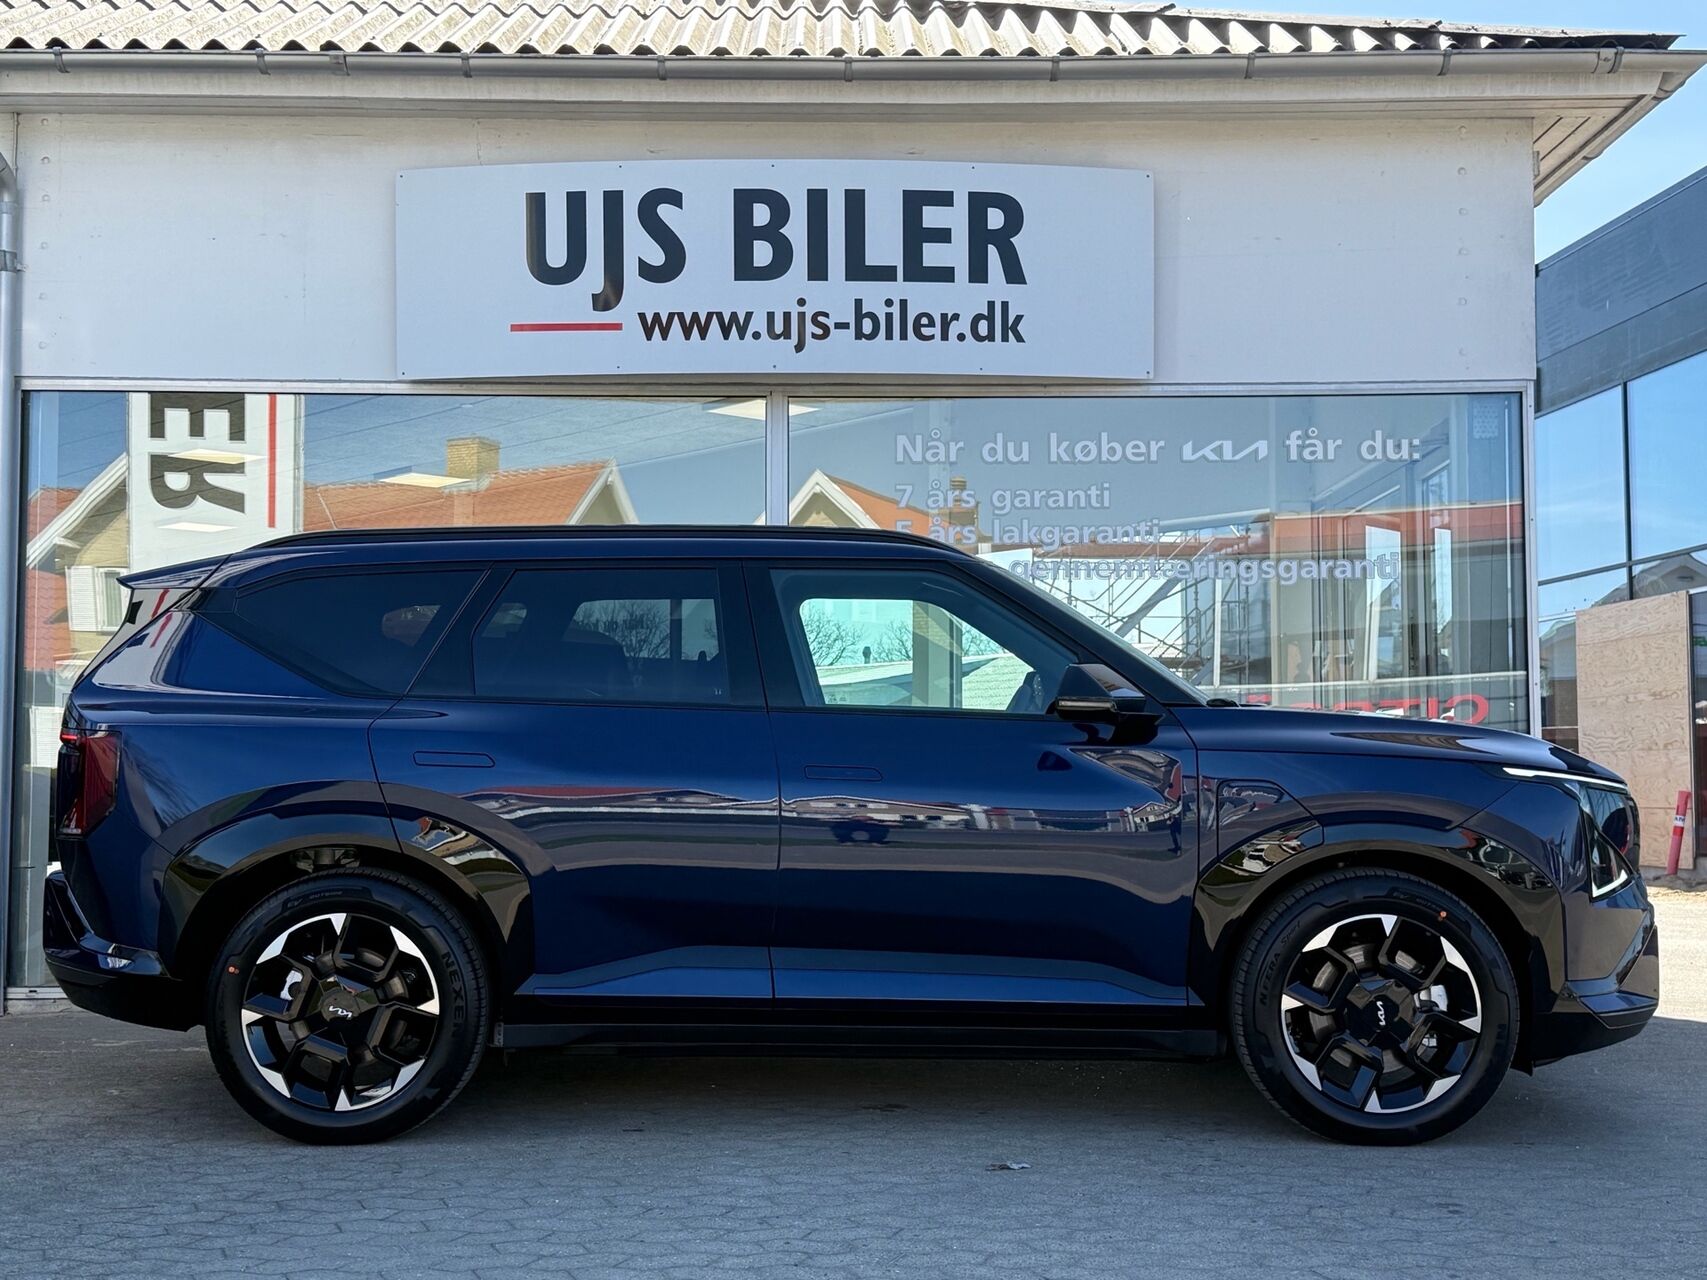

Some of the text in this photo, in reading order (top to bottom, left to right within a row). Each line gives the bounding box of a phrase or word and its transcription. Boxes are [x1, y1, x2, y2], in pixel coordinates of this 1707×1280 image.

[525, 187, 1028, 312] UJS BILER
[637, 297, 1026, 354] www.ujs-biler.dk
[895, 428, 965, 464] Når
[981, 432, 1031, 463] du
[1049, 431, 1166, 464] køber
[1286, 427, 1343, 461] får
[1360, 430, 1421, 461] du:
[895, 480, 1112, 514] 7 års garanti
[928, 516, 977, 544] års
[993, 518, 1161, 551] lakgaranti
[442, 952, 465, 1037] NEXEN
